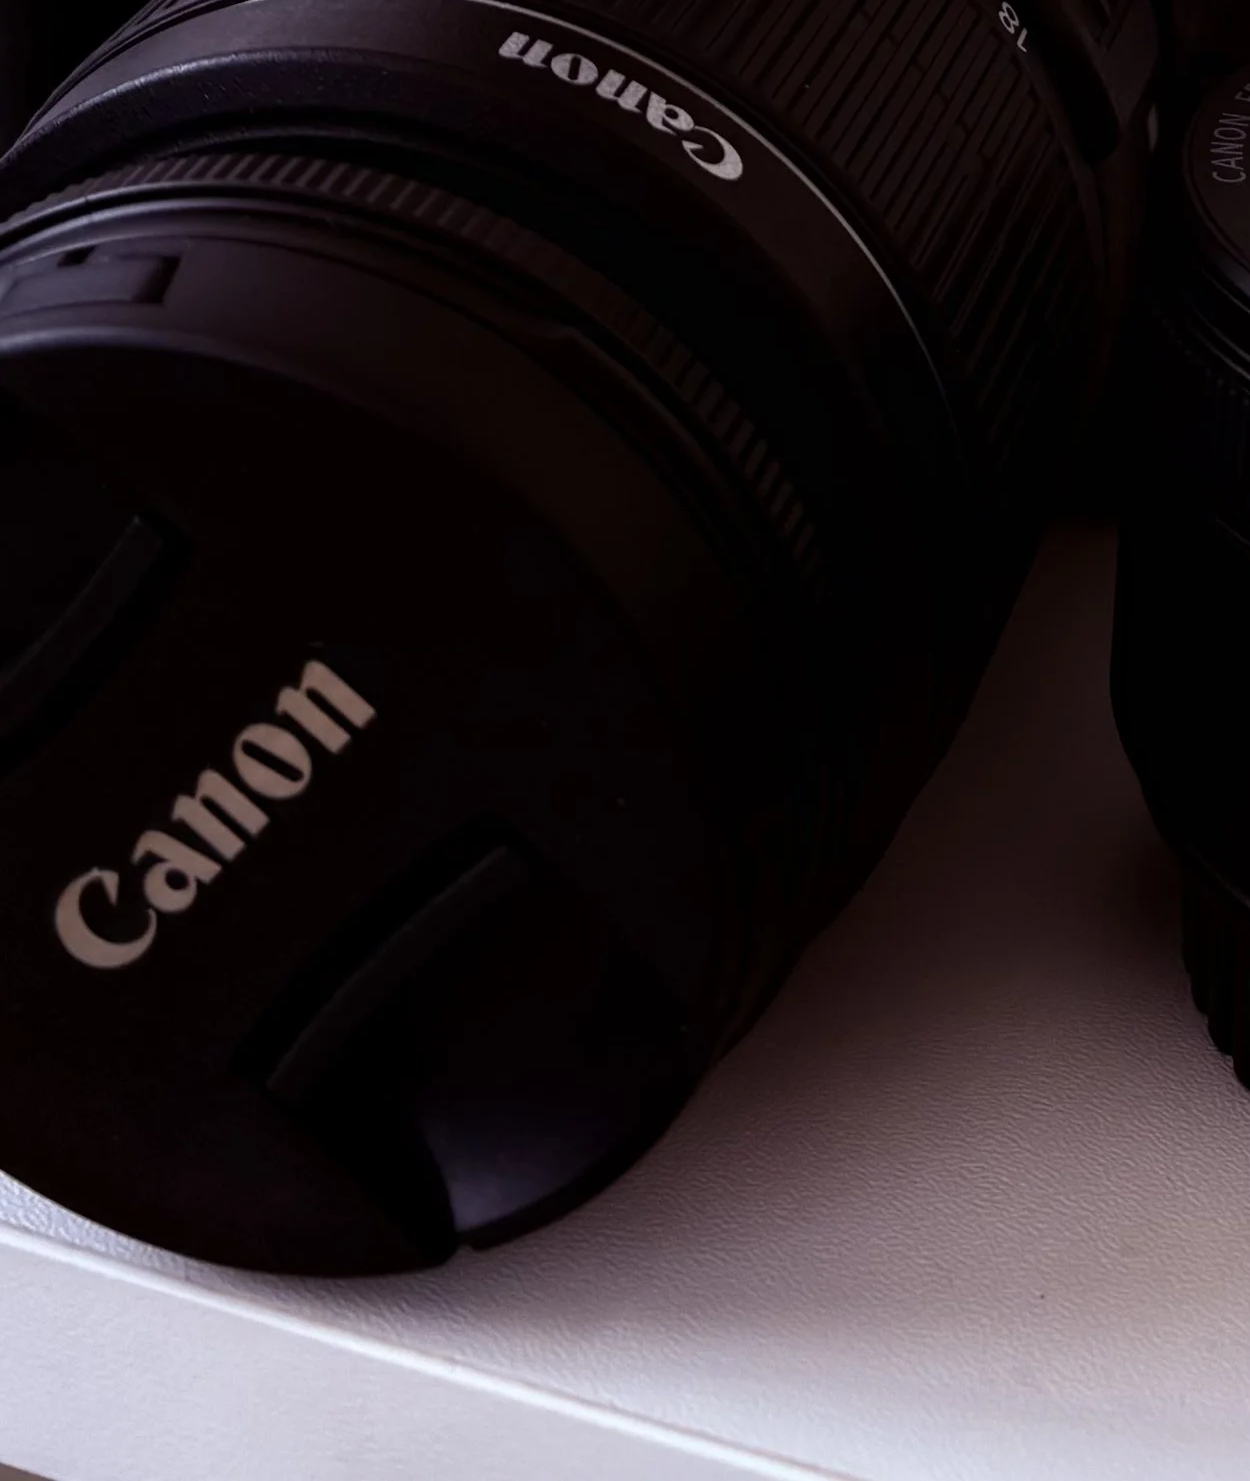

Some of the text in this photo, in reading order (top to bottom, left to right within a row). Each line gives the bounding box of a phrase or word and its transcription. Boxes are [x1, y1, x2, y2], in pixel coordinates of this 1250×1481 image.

[998, 1, 1028, 53] 18
[498, 30, 744, 182] Canon
[54, 658, 379, 970] Canon
